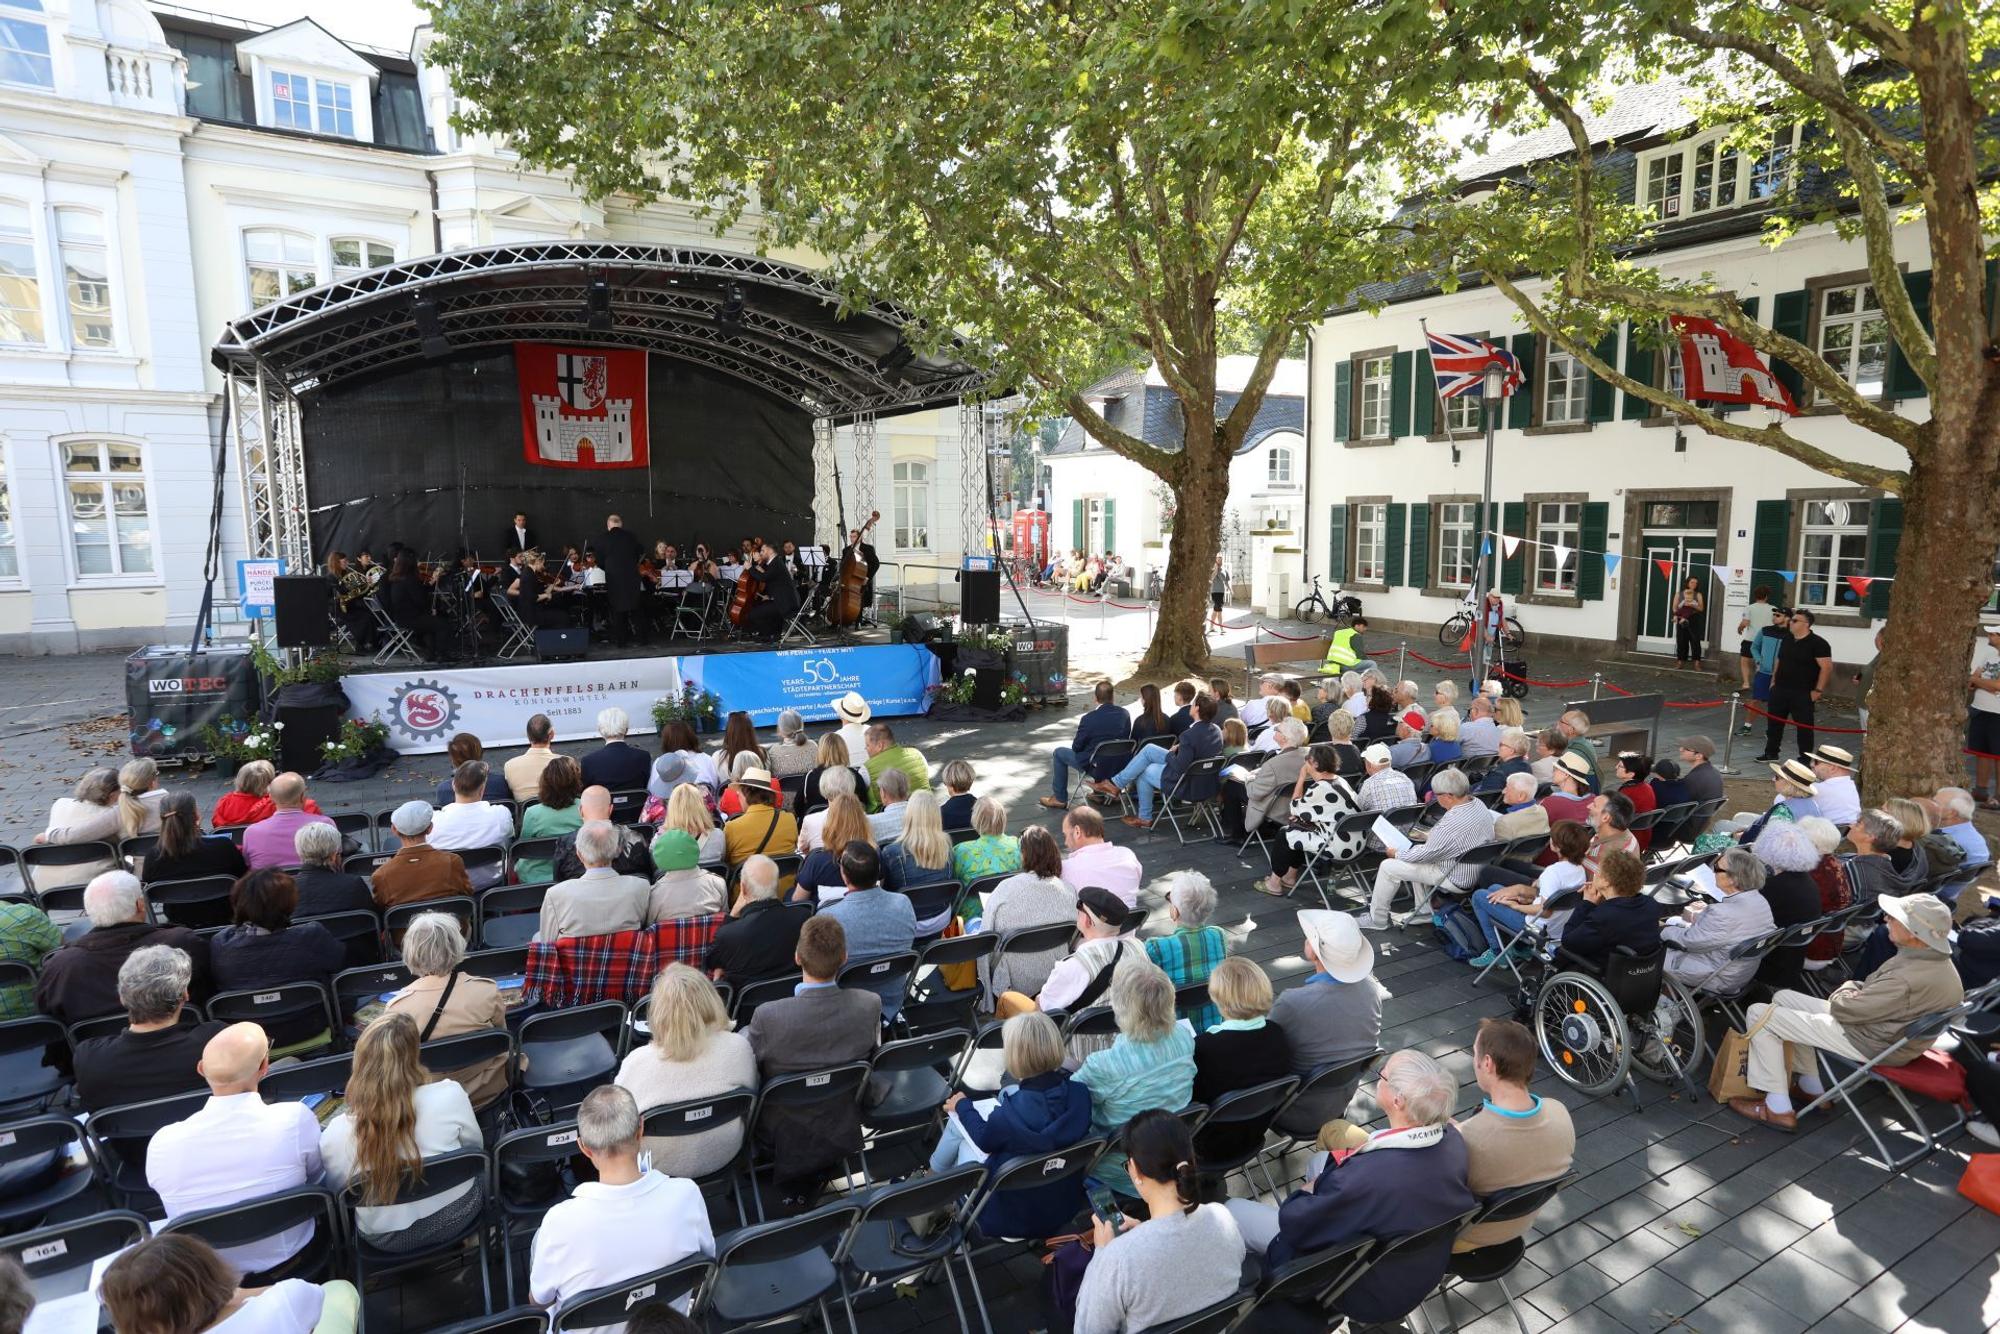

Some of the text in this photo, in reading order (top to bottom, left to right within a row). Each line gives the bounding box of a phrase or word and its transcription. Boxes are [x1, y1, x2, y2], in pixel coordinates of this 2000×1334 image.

[151, 677, 226, 691] WOTEC
[781, 678, 804, 686] YEARS
[783, 682, 861, 693] STÄDTEPARTNERSCHAFT
[474, 681, 639, 699] DRACHENFELSBAHN
[514, 693, 608, 706] KÖNIGSWINTER
[546, 708, 562, 716] Seit
[555, 1134, 570, 1142] 234
[35, 1245, 57, 1257] 164
